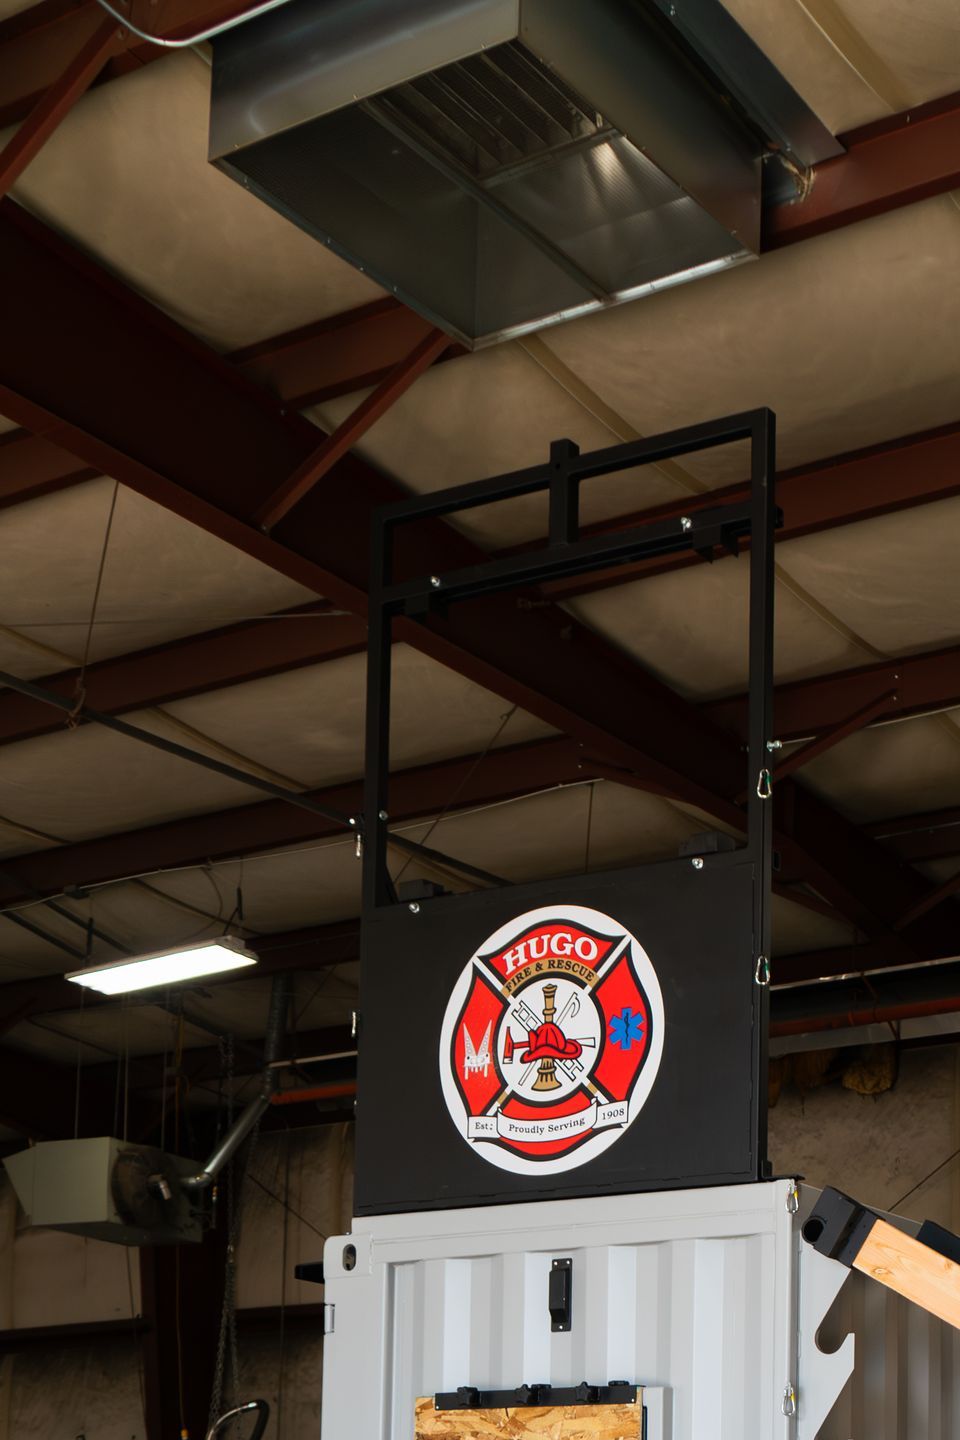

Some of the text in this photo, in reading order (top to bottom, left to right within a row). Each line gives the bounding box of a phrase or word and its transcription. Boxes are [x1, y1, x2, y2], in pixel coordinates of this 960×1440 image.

[502, 931, 599, 975] HUGO
[505, 959, 595, 993] FIRE & RESCUE
[475, 1108, 625, 1136] Est: Proudly Serving 1908
